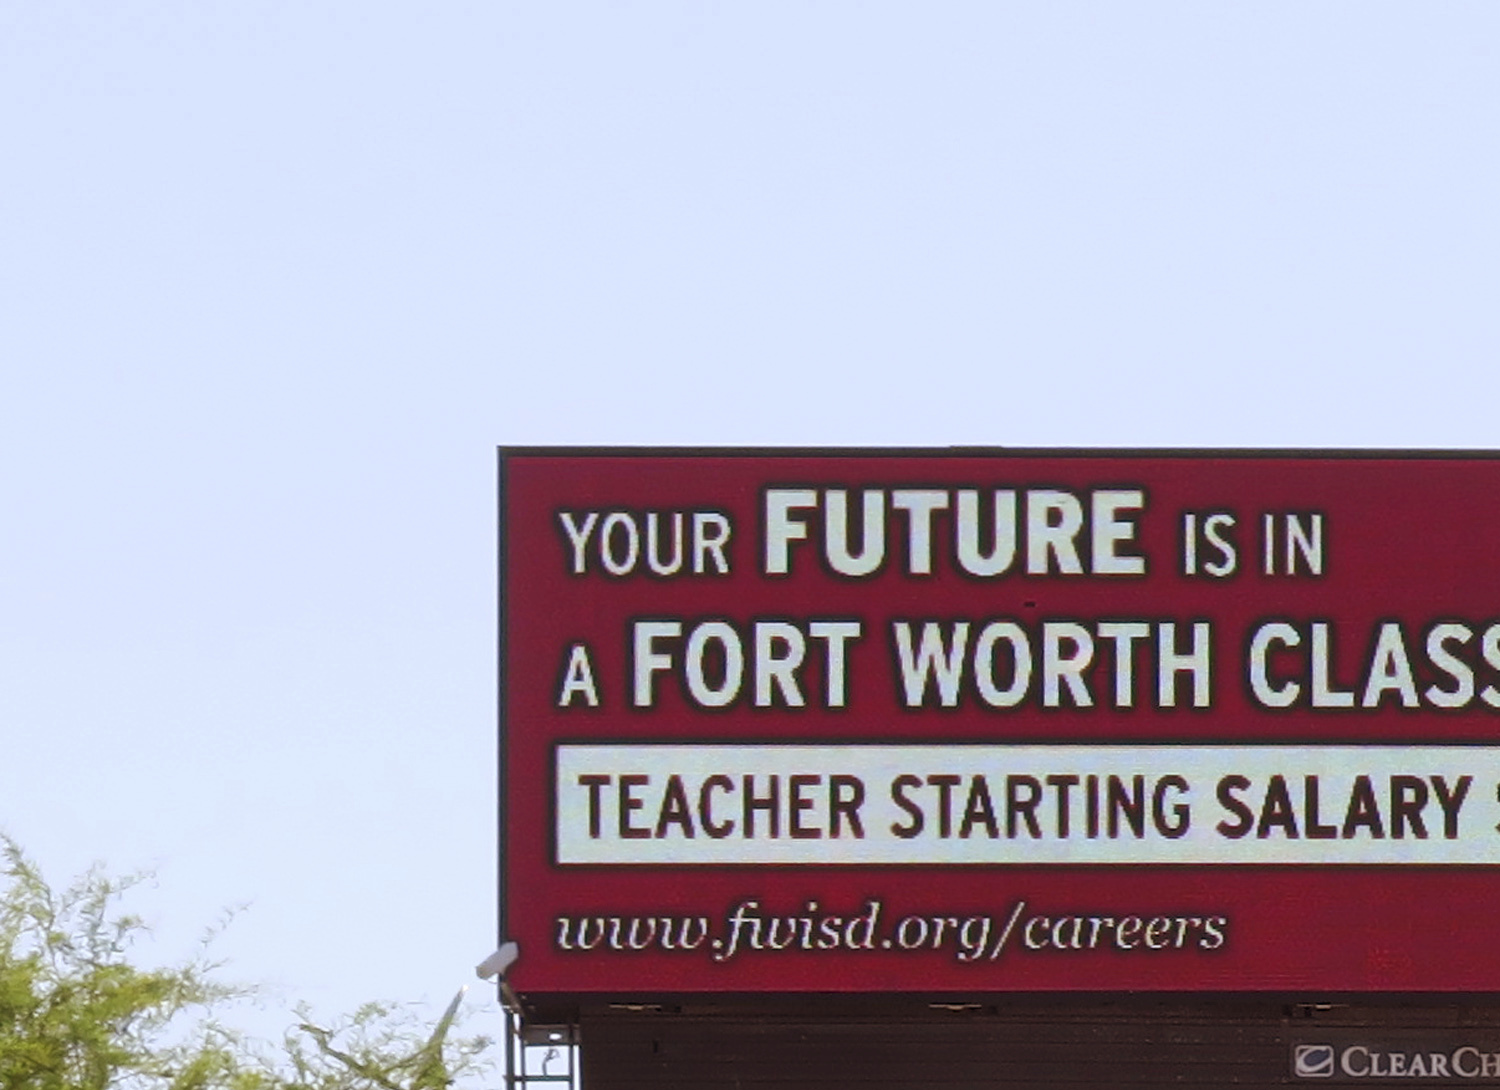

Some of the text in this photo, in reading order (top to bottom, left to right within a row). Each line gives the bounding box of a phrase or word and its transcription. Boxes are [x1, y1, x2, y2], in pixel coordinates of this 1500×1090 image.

[559, 489, 1322, 577] YOUR FUTURE IS IN
[558, 645, 599, 707] A
[633, 621, 861, 707] FORT
[893, 622, 1210, 707] WORTH
[578, 774, 866, 840] TEACHER
[890, 774, 1191, 840] STARTING
[1216, 774, 1473, 840] SALARY
[557, 901, 1226, 961] www.fwisd.org/careers
